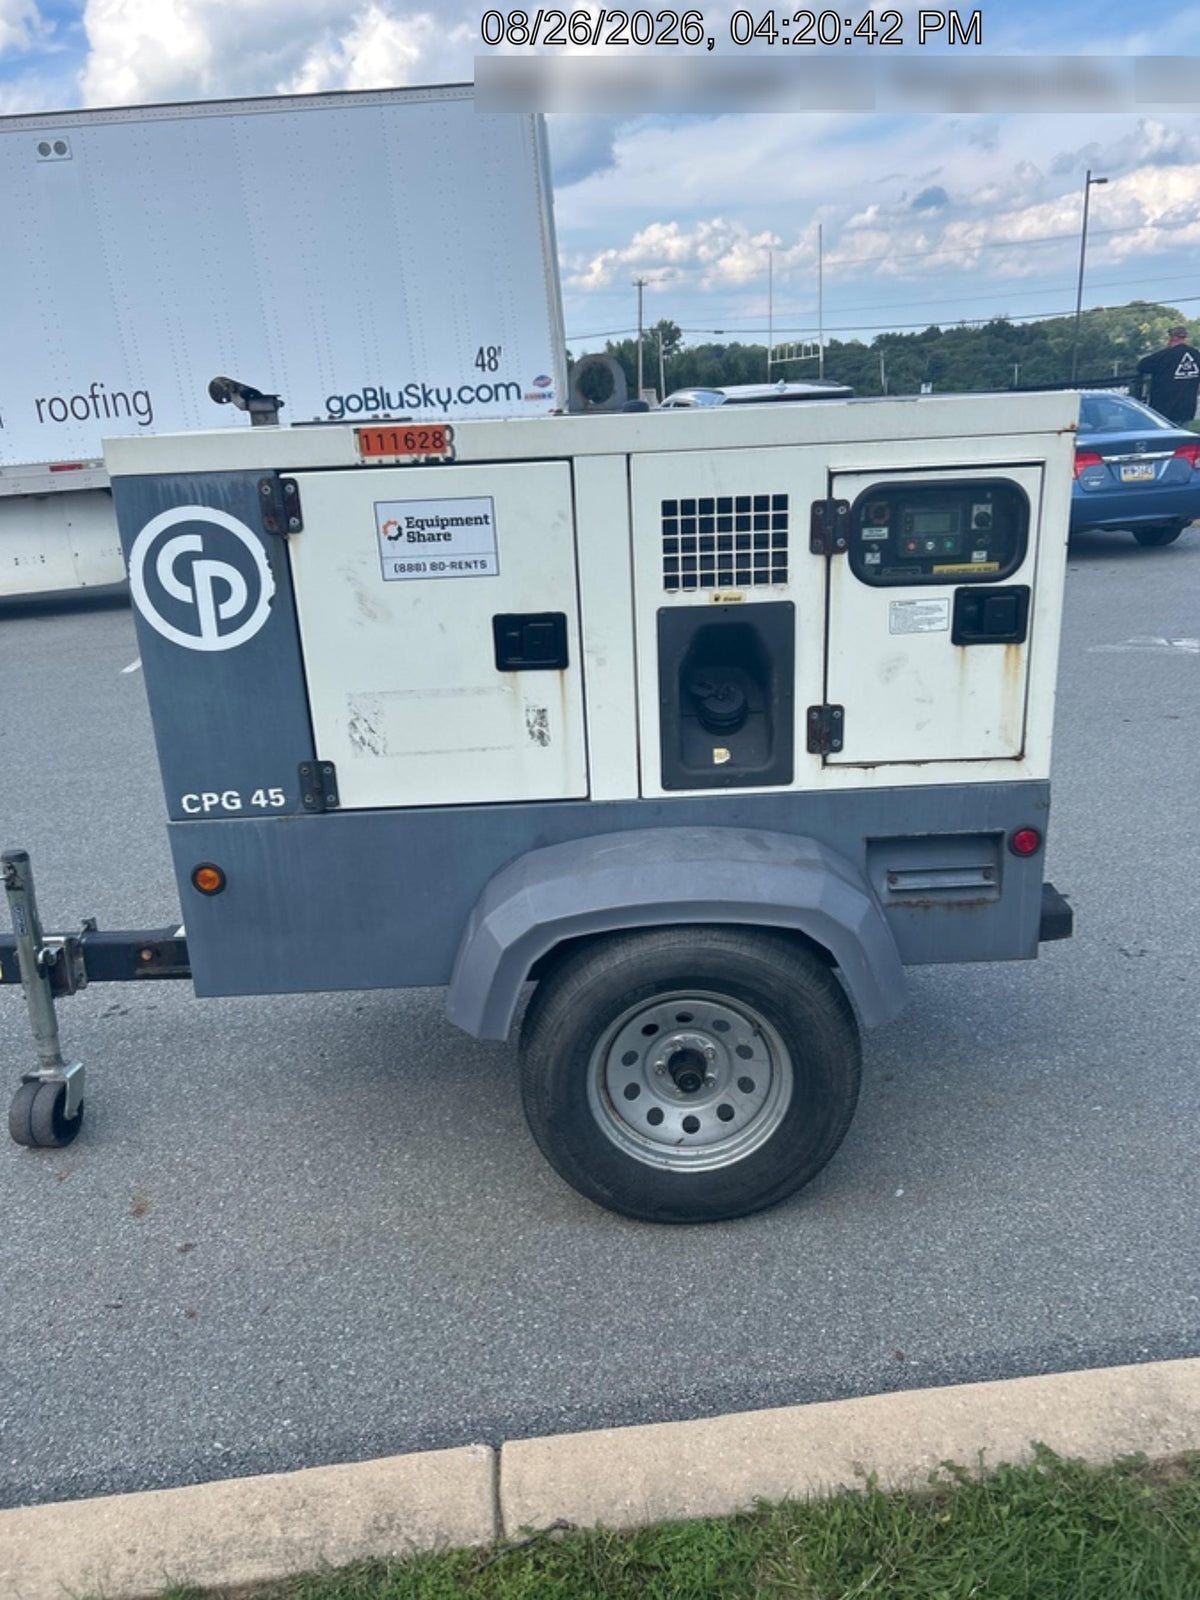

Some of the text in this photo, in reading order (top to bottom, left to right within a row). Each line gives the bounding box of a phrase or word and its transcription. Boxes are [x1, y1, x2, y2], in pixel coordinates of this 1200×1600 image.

[475, 346, 502, 372] 48'
[35, 382, 153, 426] roofing
[326, 381, 522, 418] goBluSky.com
[363, 431, 444, 451] 111628
[405, 514, 490, 530] Equipment
[406, 531, 452, 543] Share
[394, 560, 487, 573] (888) 80-RENTS
[181, 788, 286, 813] CPG 45
